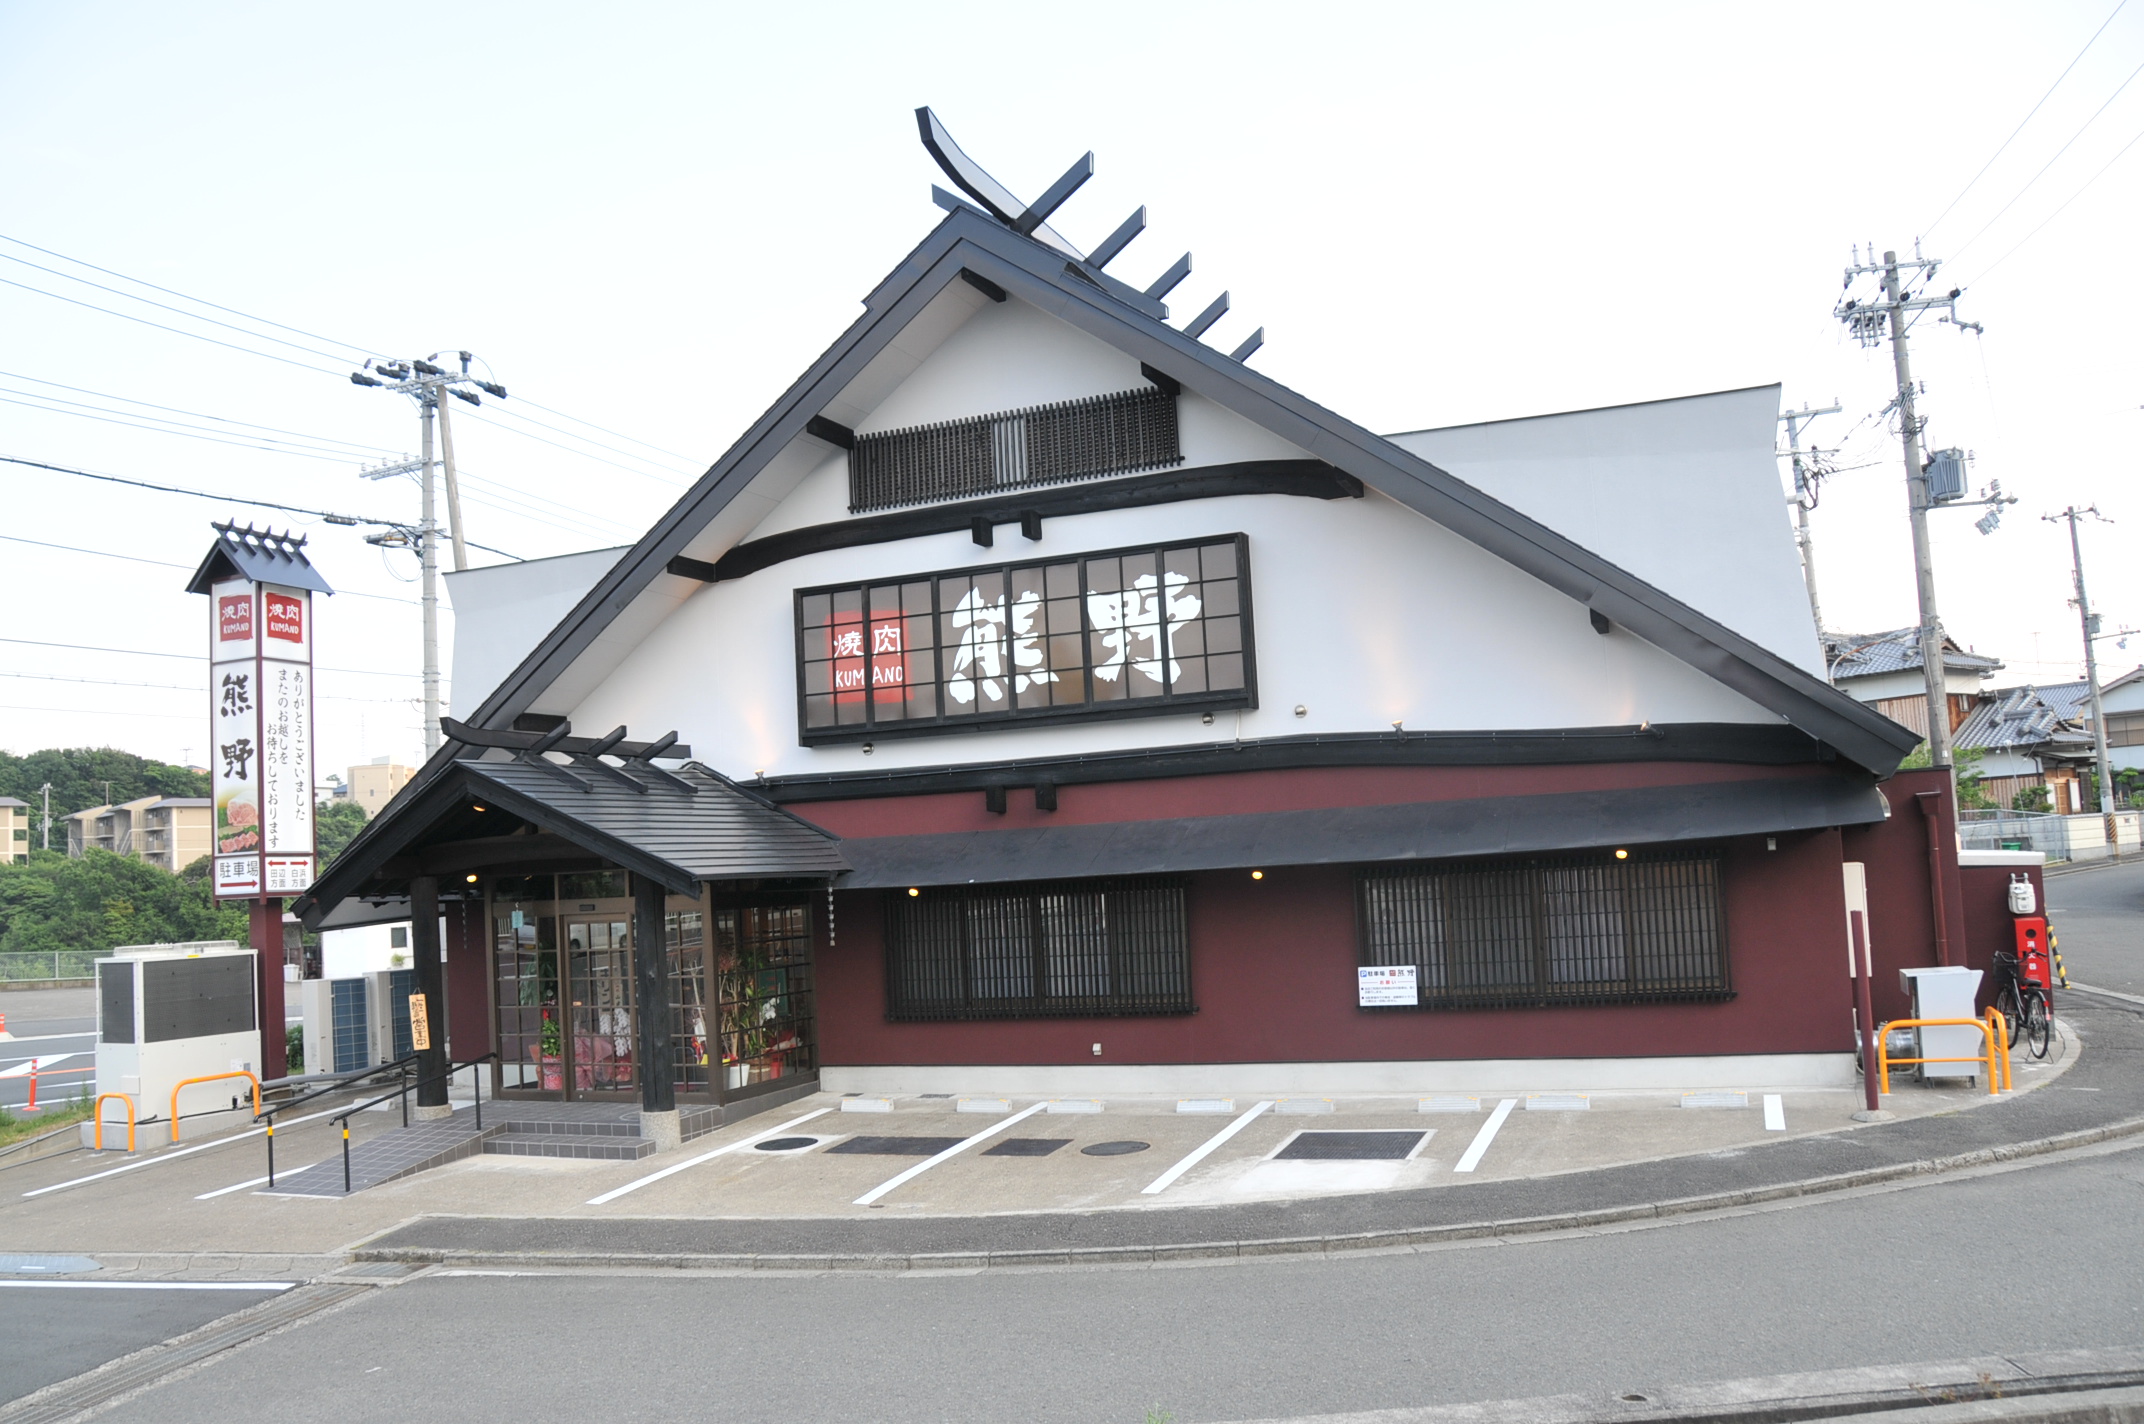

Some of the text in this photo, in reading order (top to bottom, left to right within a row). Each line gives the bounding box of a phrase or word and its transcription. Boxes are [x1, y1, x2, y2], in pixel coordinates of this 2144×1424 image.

[223, 622, 249, 634] KUMANO
[270, 621, 299, 635] KUMANO
[949, 571, 1202, 704] 熊野
[835, 666, 903, 688] KUMANO
[220, 672, 254, 781] 熊野
[277, 669, 289, 765] またのお越しを
[293, 669, 305, 821] ありがとうございました
[266, 723, 279, 849] お待ちしております
[220, 861, 259, 878] 駐車場
[270, 869, 286, 878] 田辺
[270, 879, 286, 888] 方面
[291, 879, 307, 888] 方面
